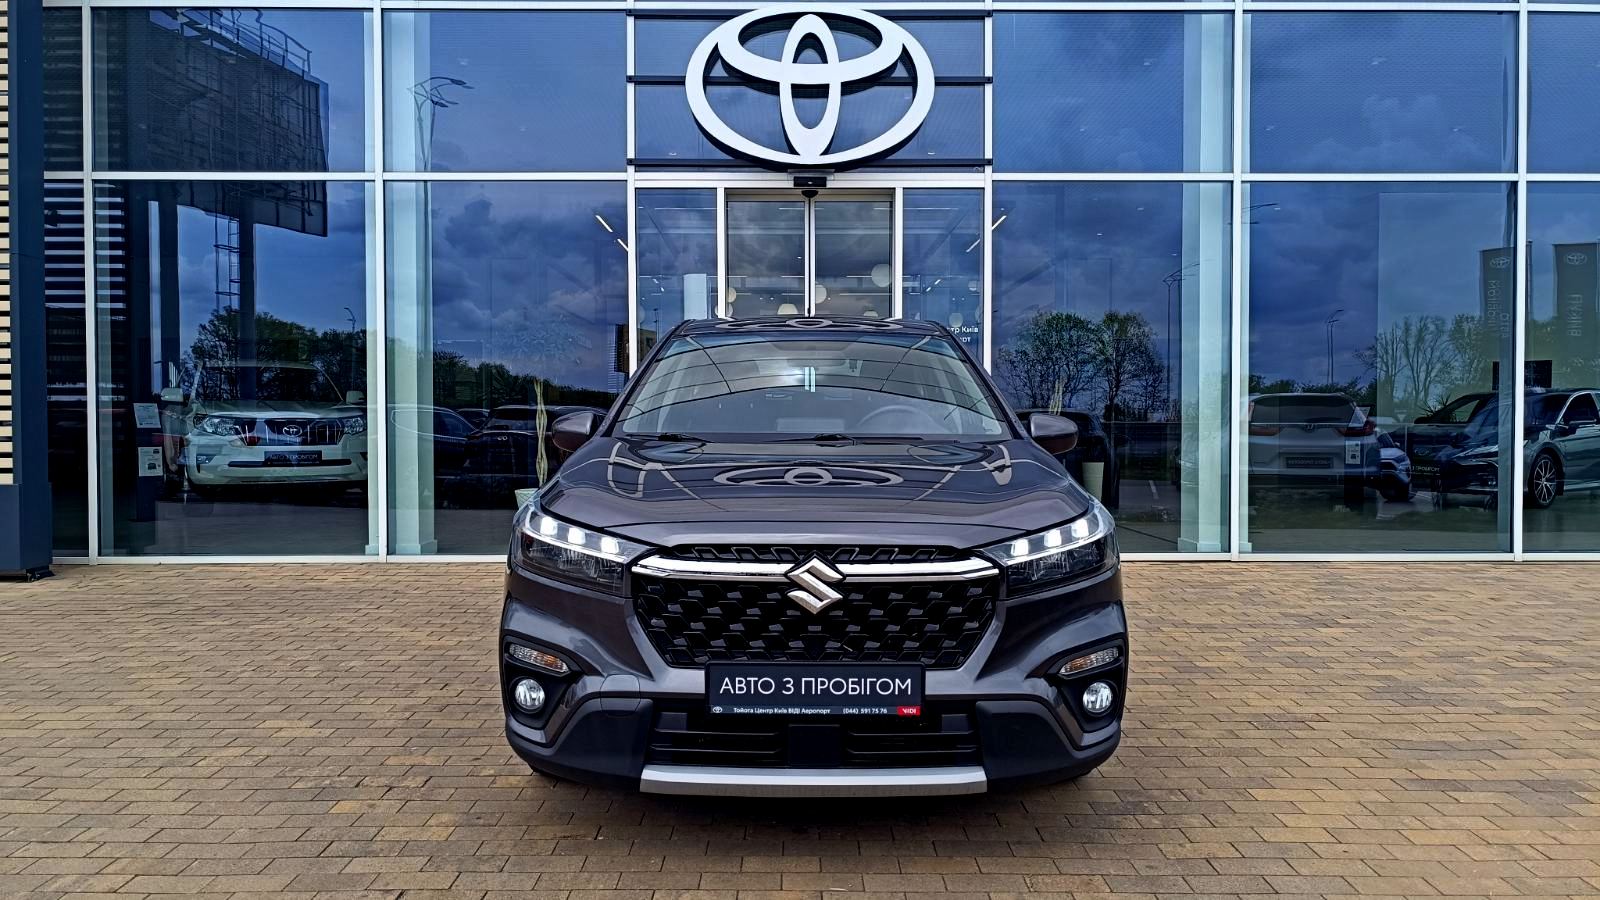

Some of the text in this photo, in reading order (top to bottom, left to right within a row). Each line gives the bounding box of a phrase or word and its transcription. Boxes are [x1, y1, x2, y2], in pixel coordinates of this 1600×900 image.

[719, 677, 776, 695] АВТО
[801, 677, 912, 696] ПРОБІГОМ
[755, 707, 774, 715] Центр
[801, 707, 831, 715] Аеропорт
[842, 707, 859, 715] (044)
